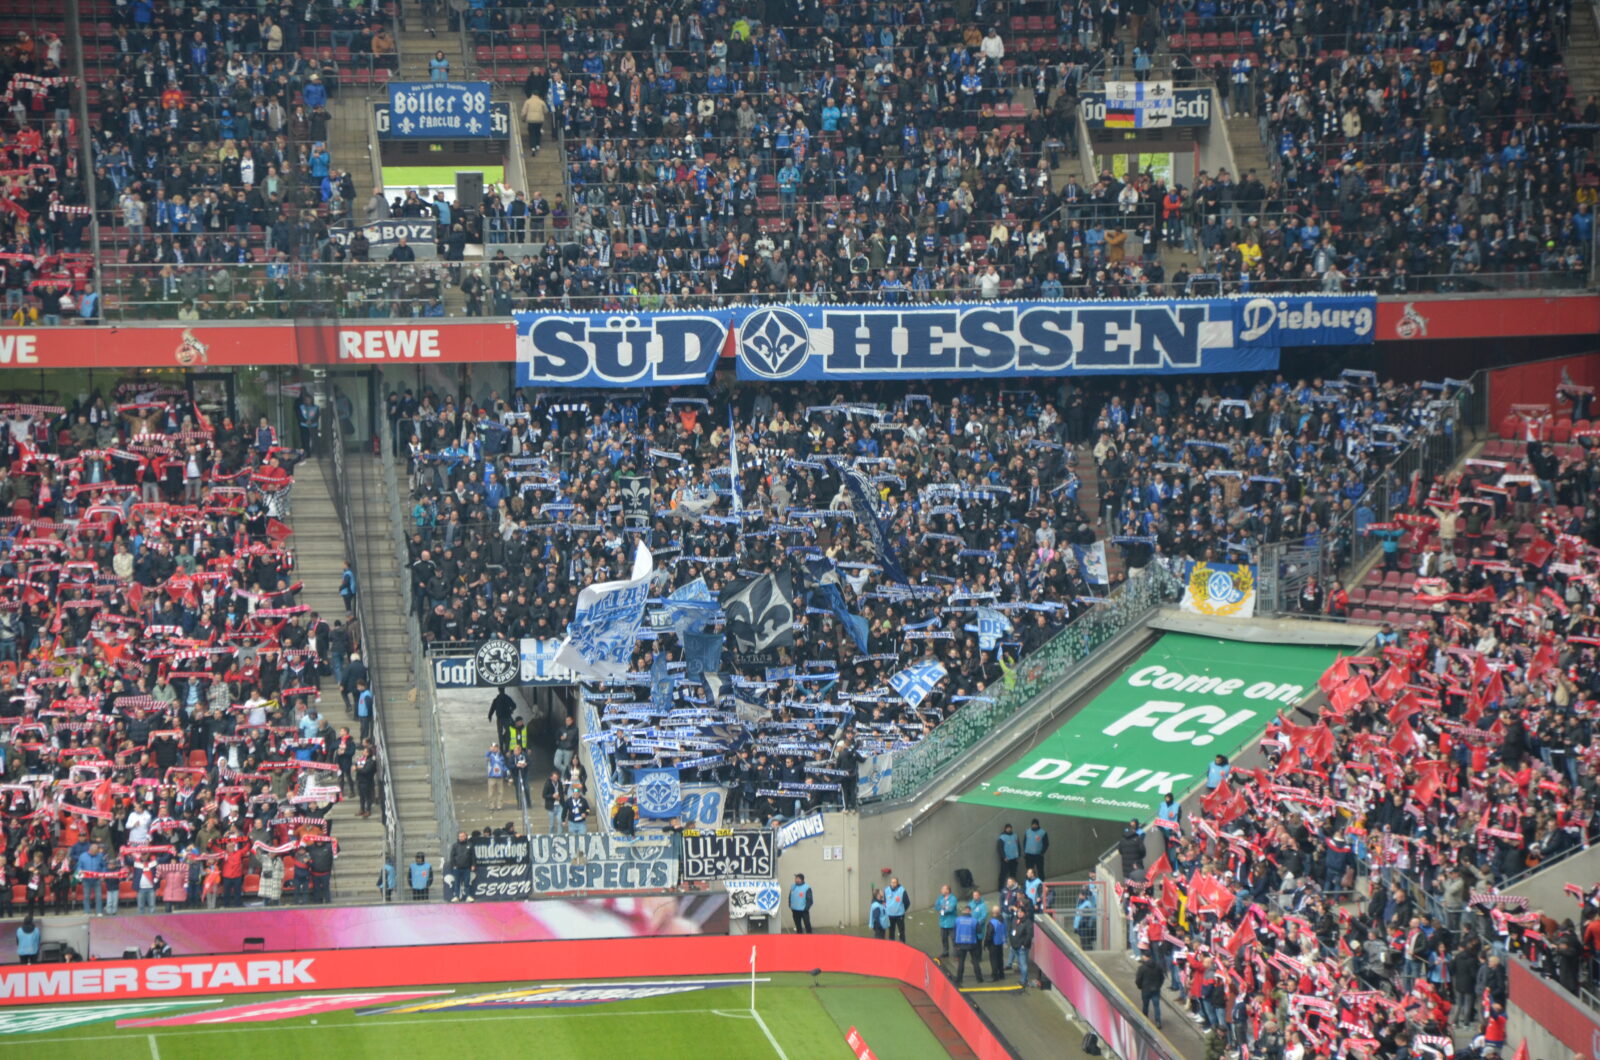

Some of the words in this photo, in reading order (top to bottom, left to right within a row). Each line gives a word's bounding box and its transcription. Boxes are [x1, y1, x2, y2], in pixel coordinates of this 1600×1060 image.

[394, 91, 456, 114] Böller
[462, 91, 486, 114] 98
[382, 225, 432, 239] BOYZ
[1240, 298, 1373, 342] Dieburg
[339, 329, 441, 359] REWE
[529, 315, 727, 383] SÜD
[823, 304, 1209, 373] HESSEN
[478, 640, 518, 658] DARMSTADT
[496, 665, 517, 683] SPORT
[1128, 665, 1245, 696] Come
[1102, 700, 1257, 746] FC!
[1017, 758, 1193, 795] DEVK
[475, 838, 527, 862] underdogs
[686, 834, 769, 858] ULTRA
[486, 864, 527, 878] ROW
[533, 861, 668, 891] SUSPECTS
[687, 858, 716, 875] DE
[740, 857, 769, 874] LIS
[475, 881, 531, 896] SEVEN
[0, 967, 138, 998] MMER
[145, 958, 316, 990] STARK
